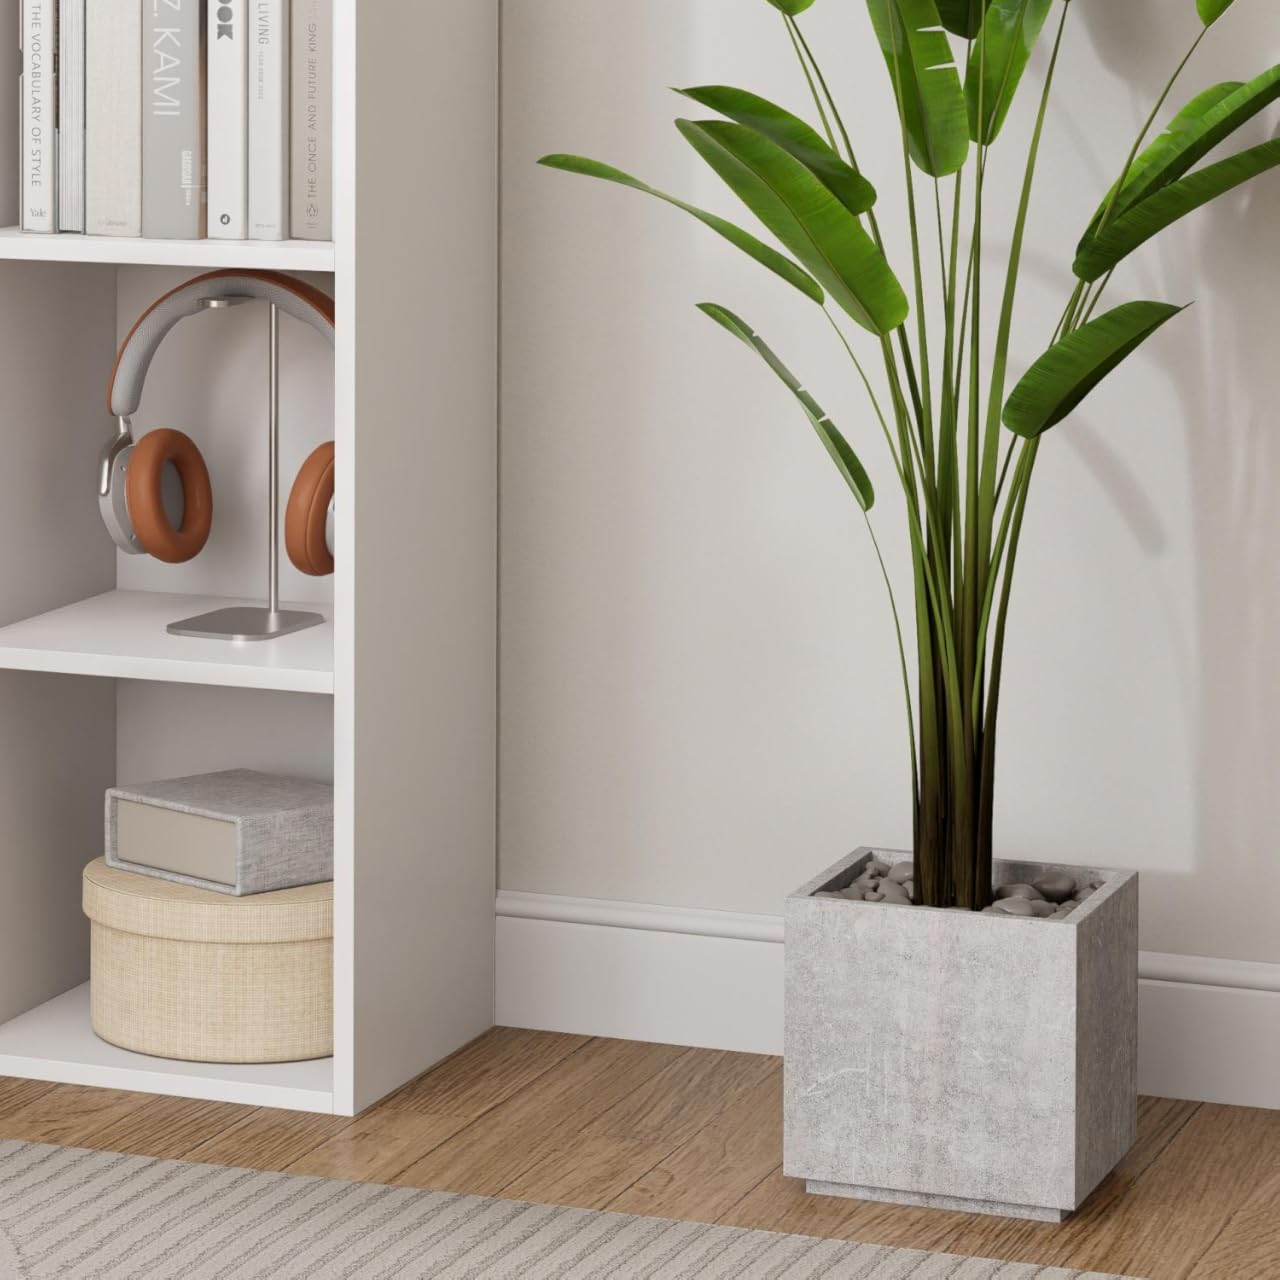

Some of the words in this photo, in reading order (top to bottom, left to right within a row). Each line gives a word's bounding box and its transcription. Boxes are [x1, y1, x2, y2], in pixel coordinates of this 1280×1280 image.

[31, 3, 41, 29] THE
[258, 3, 270, 45] LIVING
[308, 23, 318, 52] KING
[31, 33, 41, 122] VOCABULARY
[153, 27, 182, 116] KAMI
[307, 58, 318, 100] FUTURE
[31, 127, 41, 144] OF
[307, 104, 317, 130] AND
[31, 149, 41, 187] STYLE
[307, 136, 317, 173] ONCE
[307, 178, 317, 198] THE
